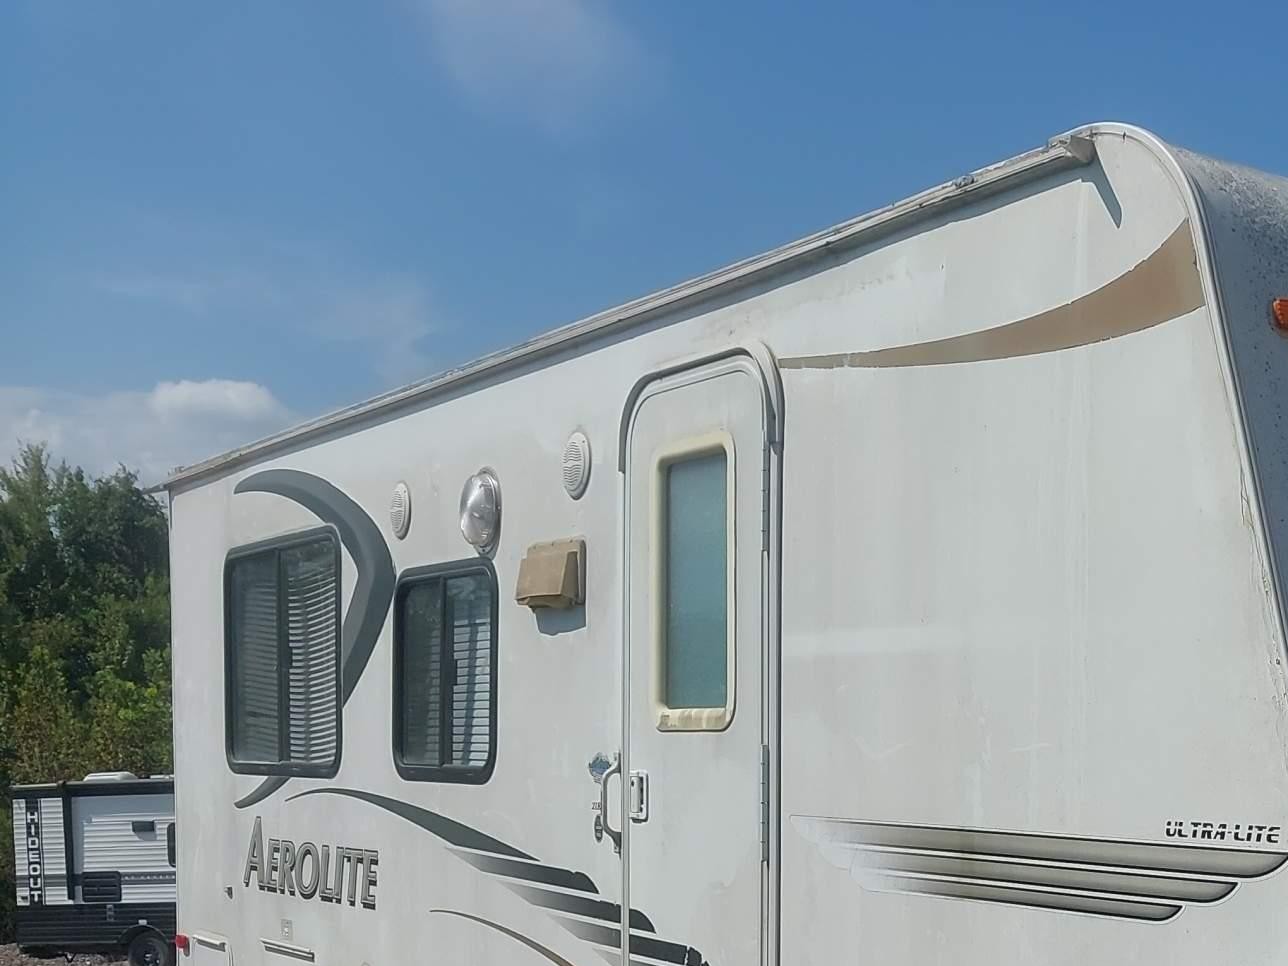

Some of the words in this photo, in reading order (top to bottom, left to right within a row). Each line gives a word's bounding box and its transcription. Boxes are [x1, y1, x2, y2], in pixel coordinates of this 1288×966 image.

[26, 811, 42, 902] HIDEOUT
[243, 815, 379, 911] AEROLITE
[1165, 820, 1281, 844] ULTRA-LITE
